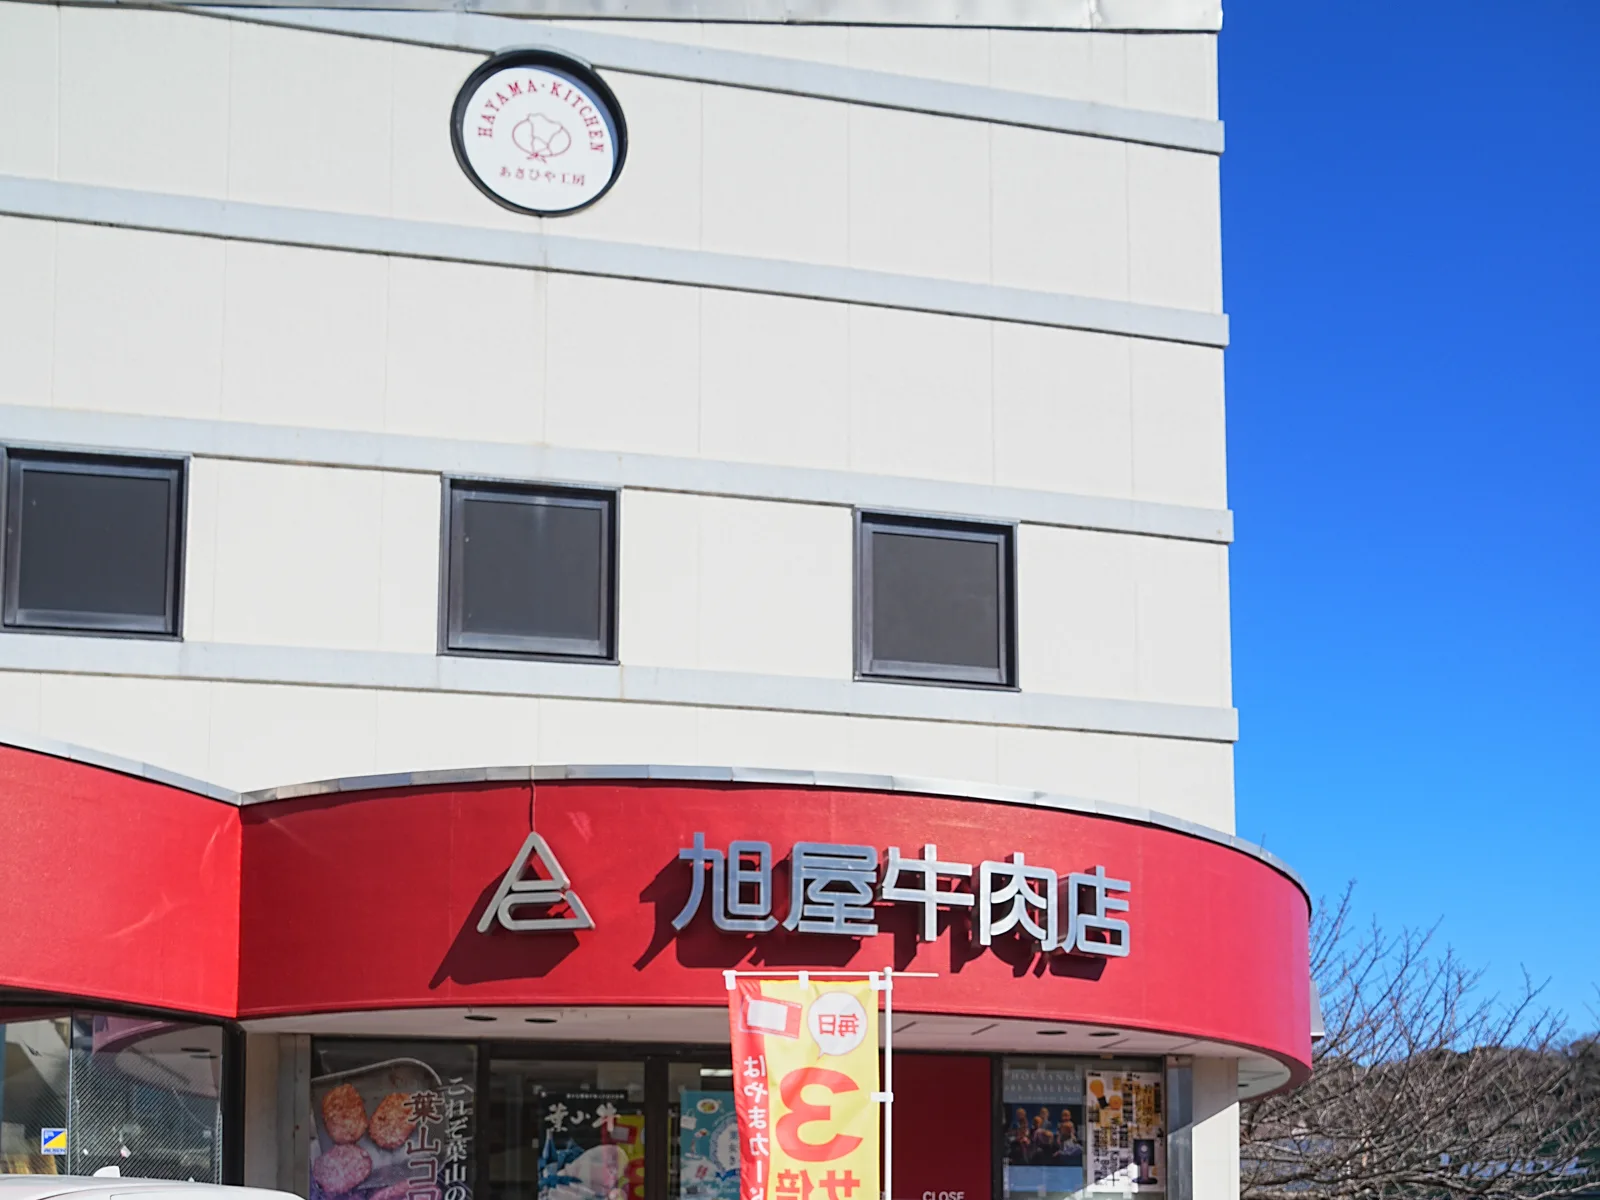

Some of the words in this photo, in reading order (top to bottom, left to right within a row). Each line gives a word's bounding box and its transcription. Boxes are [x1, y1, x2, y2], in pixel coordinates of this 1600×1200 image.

[478, 79, 538, 139] HAYAMA
[550, 81, 605, 152] KITCHEN
[671, 832, 1131, 957] 旭屋牛肉店
